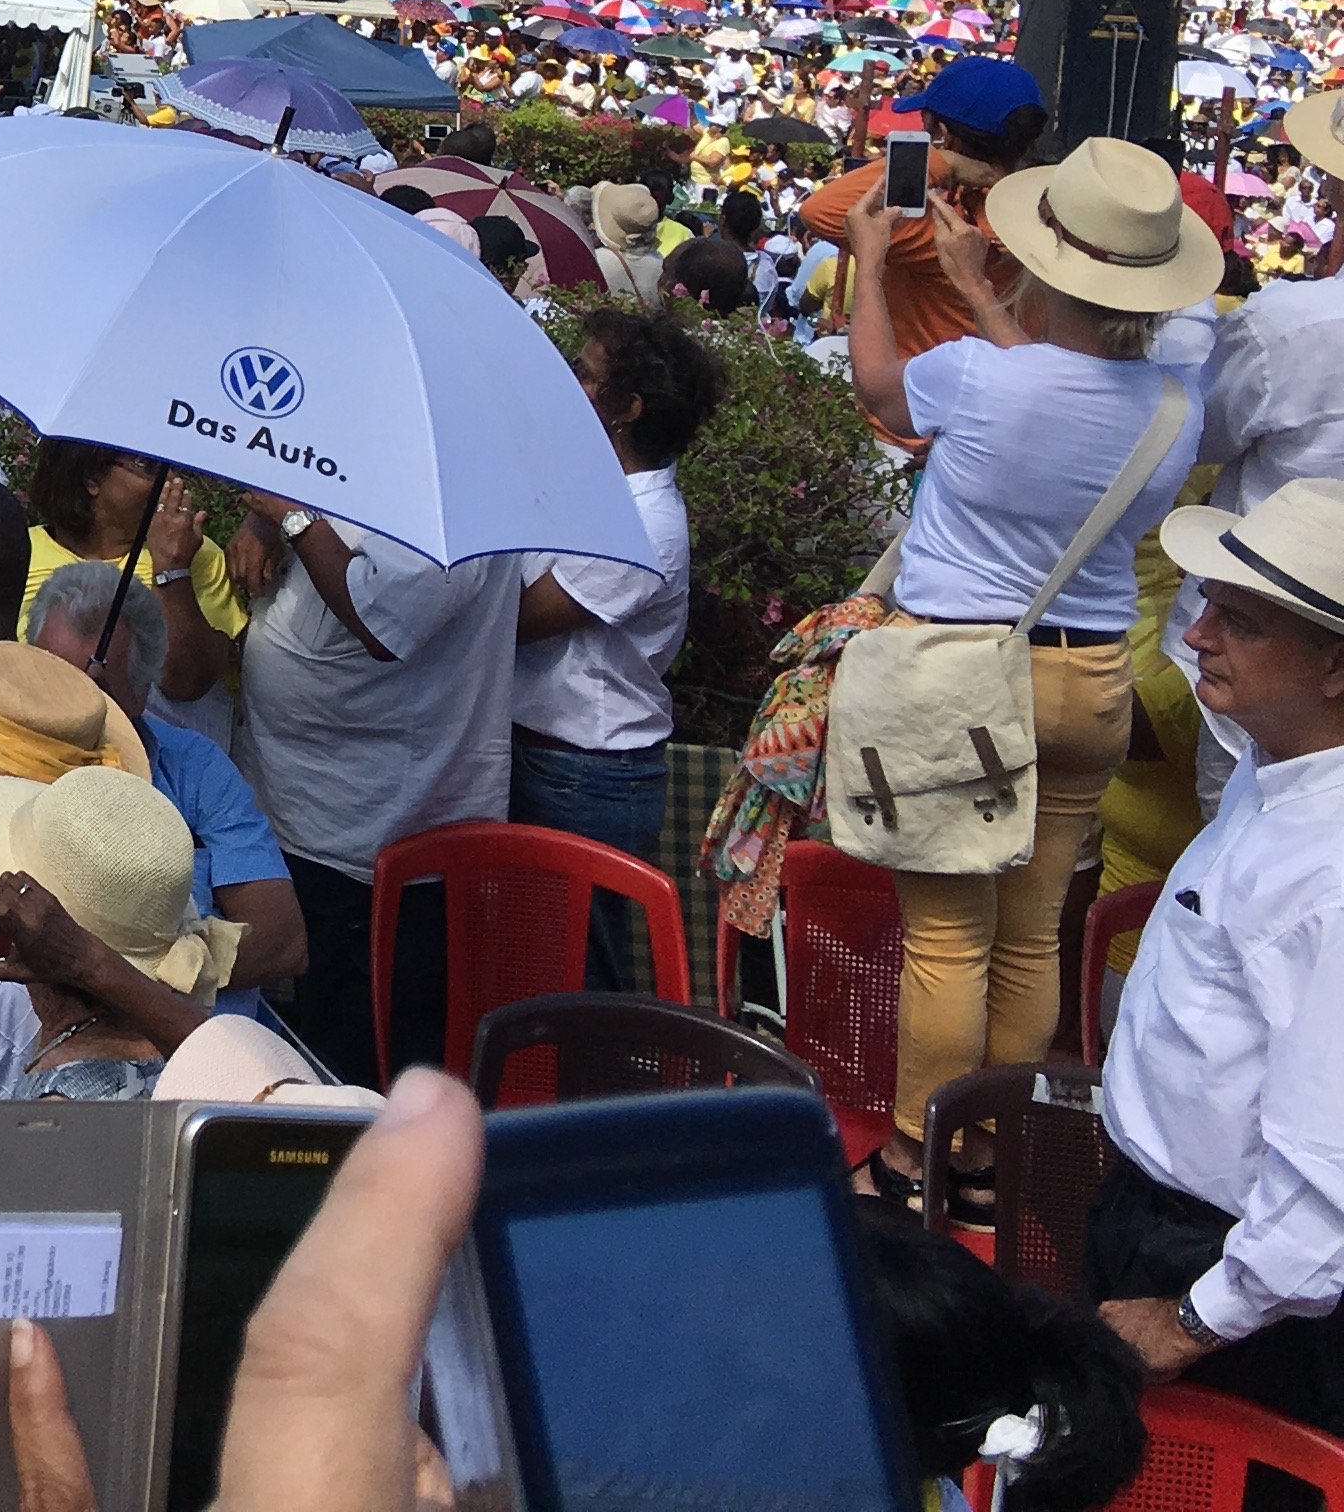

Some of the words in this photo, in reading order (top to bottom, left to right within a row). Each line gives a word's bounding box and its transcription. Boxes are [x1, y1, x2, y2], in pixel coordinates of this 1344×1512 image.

[167, 399, 238, 444] Das
[246, 426, 348, 483] Auto.
[269, 1150, 330, 1165] SAMSUNG
